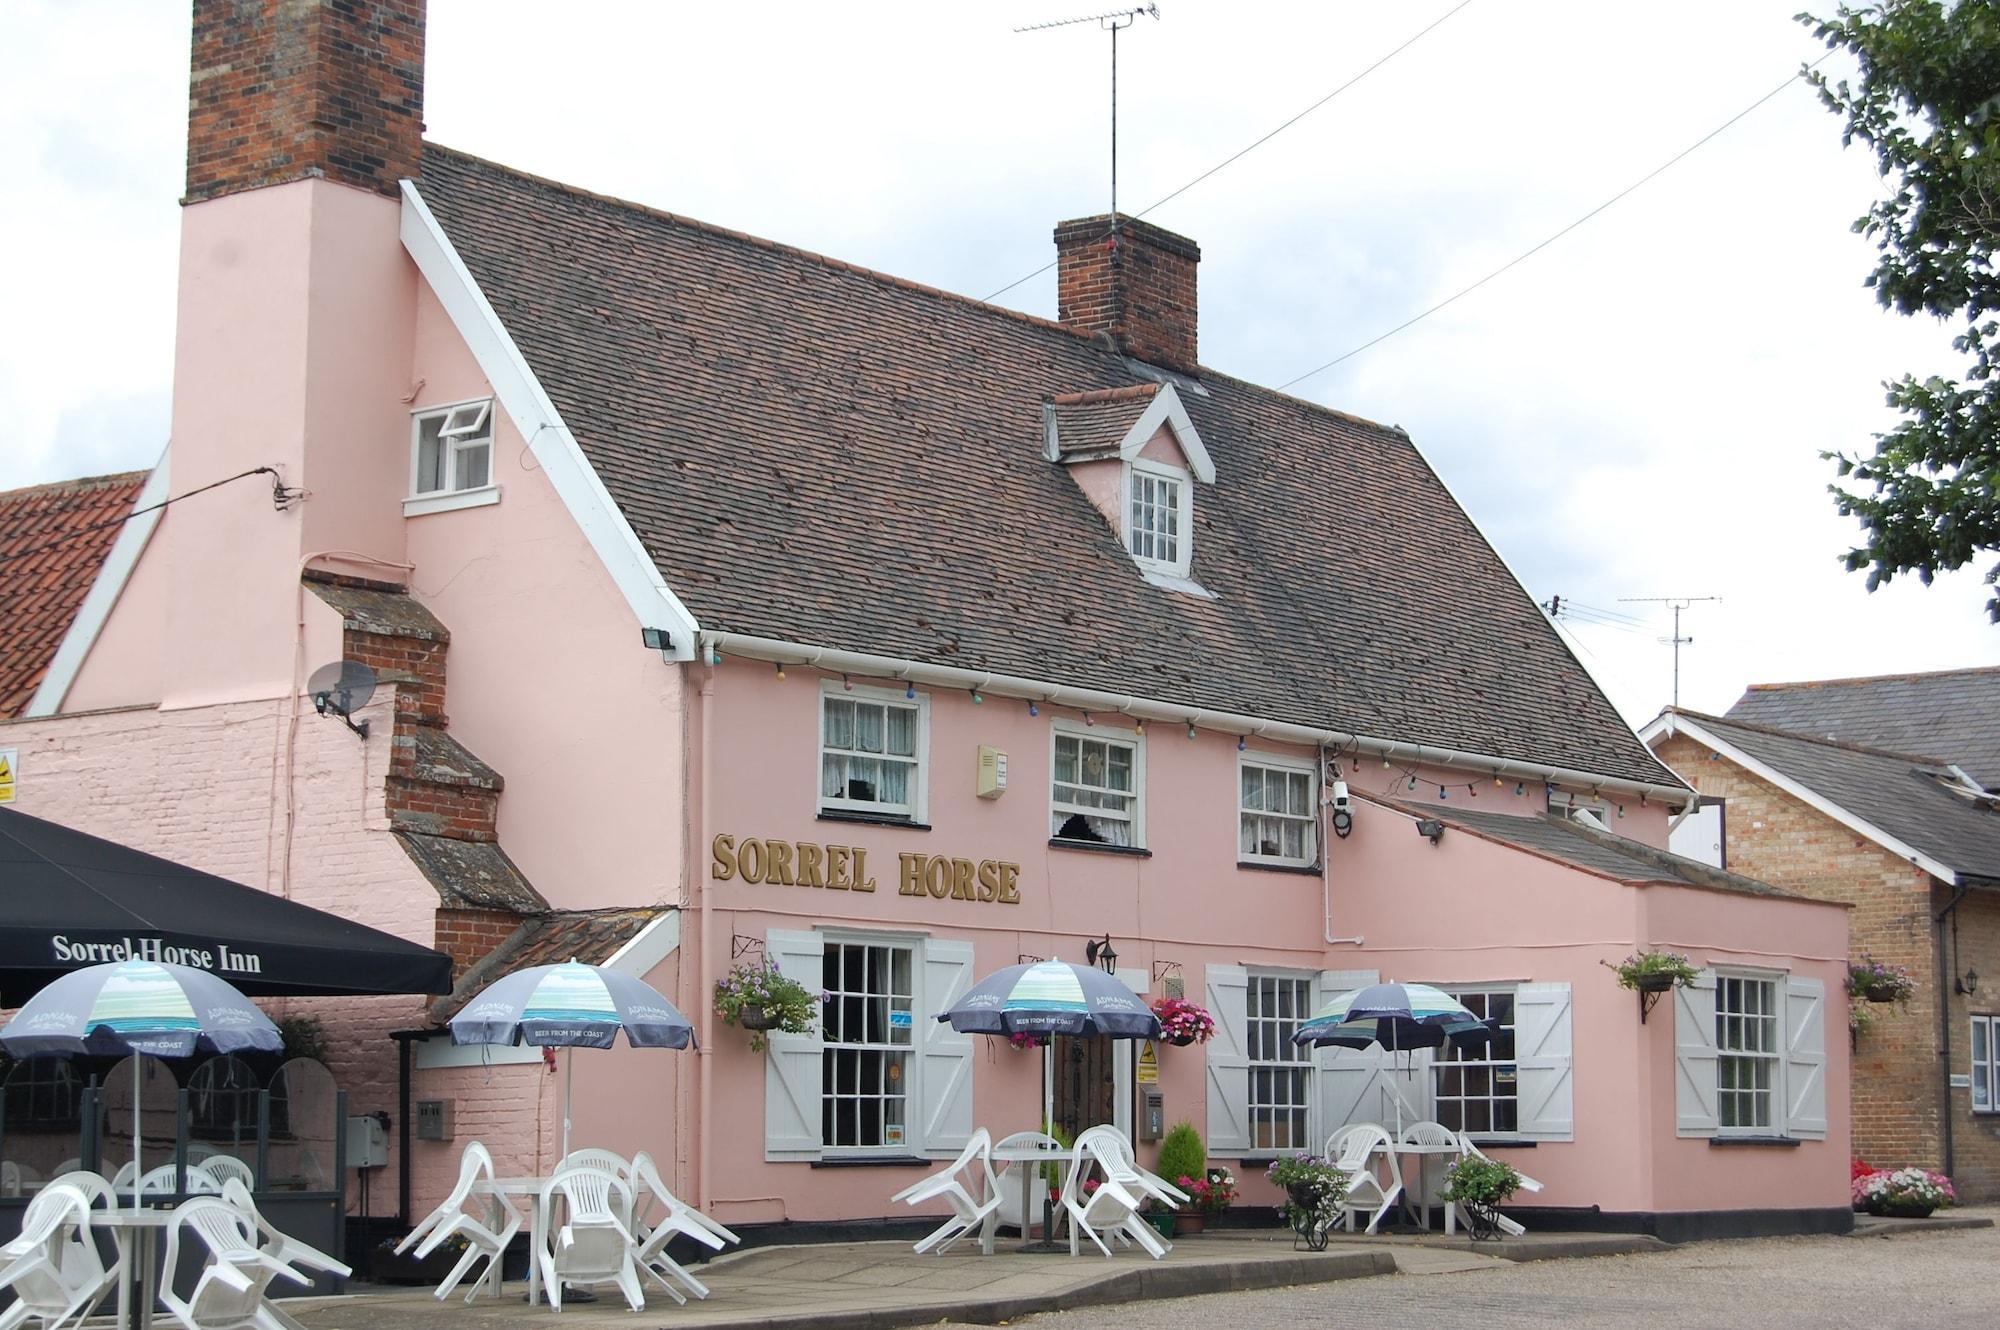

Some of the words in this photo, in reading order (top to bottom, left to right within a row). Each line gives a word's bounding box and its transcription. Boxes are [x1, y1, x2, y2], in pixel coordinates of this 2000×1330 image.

[712, 833, 876, 893] SORREL
[898, 851, 1021, 905] HORSE
[52, 934, 133, 962] Sorrel
[139, 938, 213, 969] Horse
[217, 944, 261, 974] Inn
[158, 1041, 183, 1049] COAST
[534, 1029, 549, 1037] BEER
[550, 1029, 569, 1037] FROM
[569, 1029, 582, 1037] THE
[583, 1030, 604, 1038] COAST
